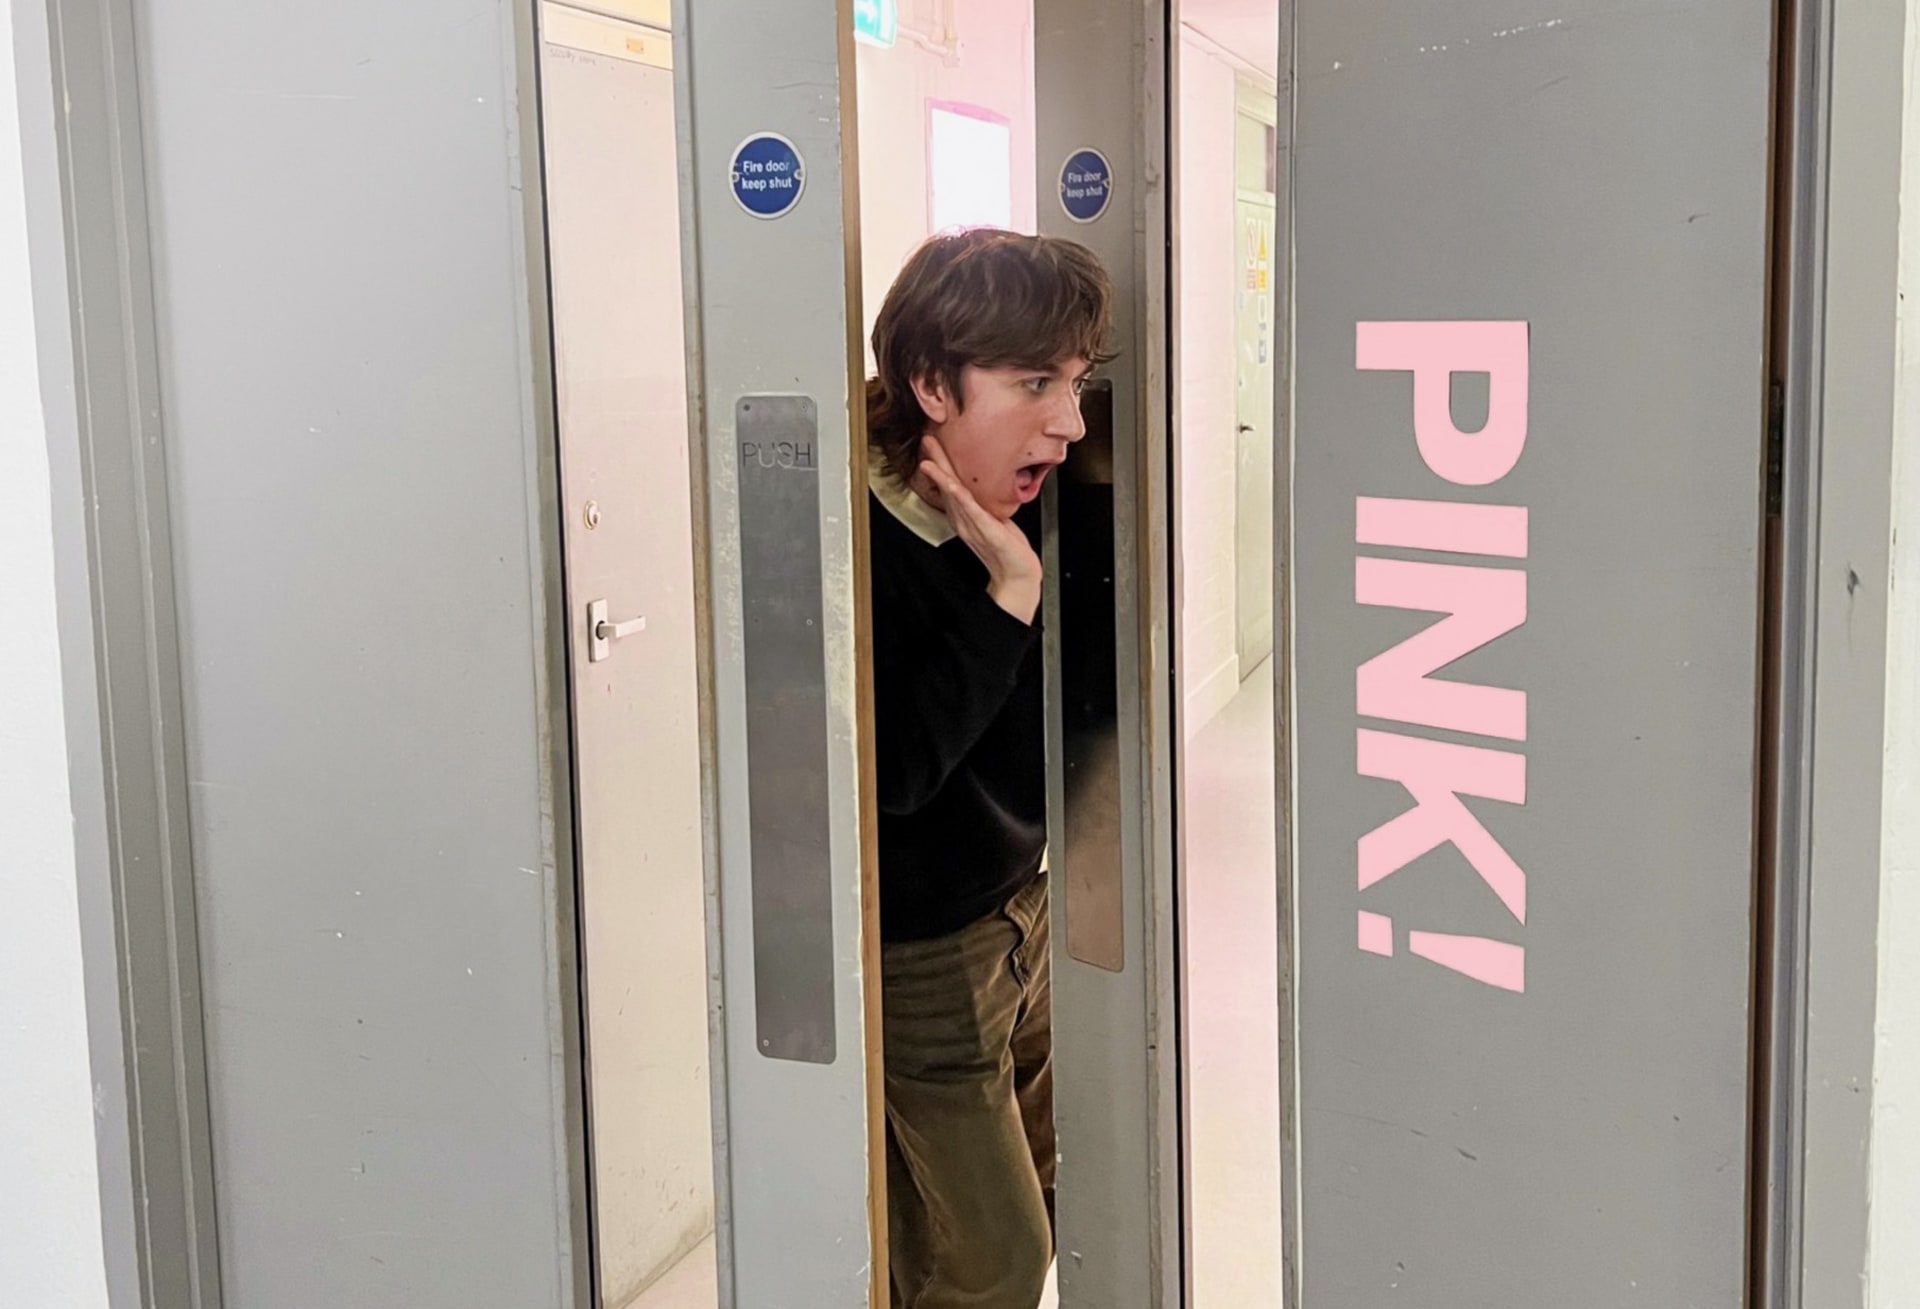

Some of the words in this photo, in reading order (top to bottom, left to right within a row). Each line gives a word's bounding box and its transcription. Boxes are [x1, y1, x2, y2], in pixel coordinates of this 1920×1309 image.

[743, 160, 763, 173] Fire
[765, 159, 790, 172] door
[742, 177, 767, 192] keep
[769, 176, 793, 189] shut
[1083, 171, 1102, 183] door
[741, 442, 812, 469] PUSH
[1355, 320, 1529, 993] PINK!
